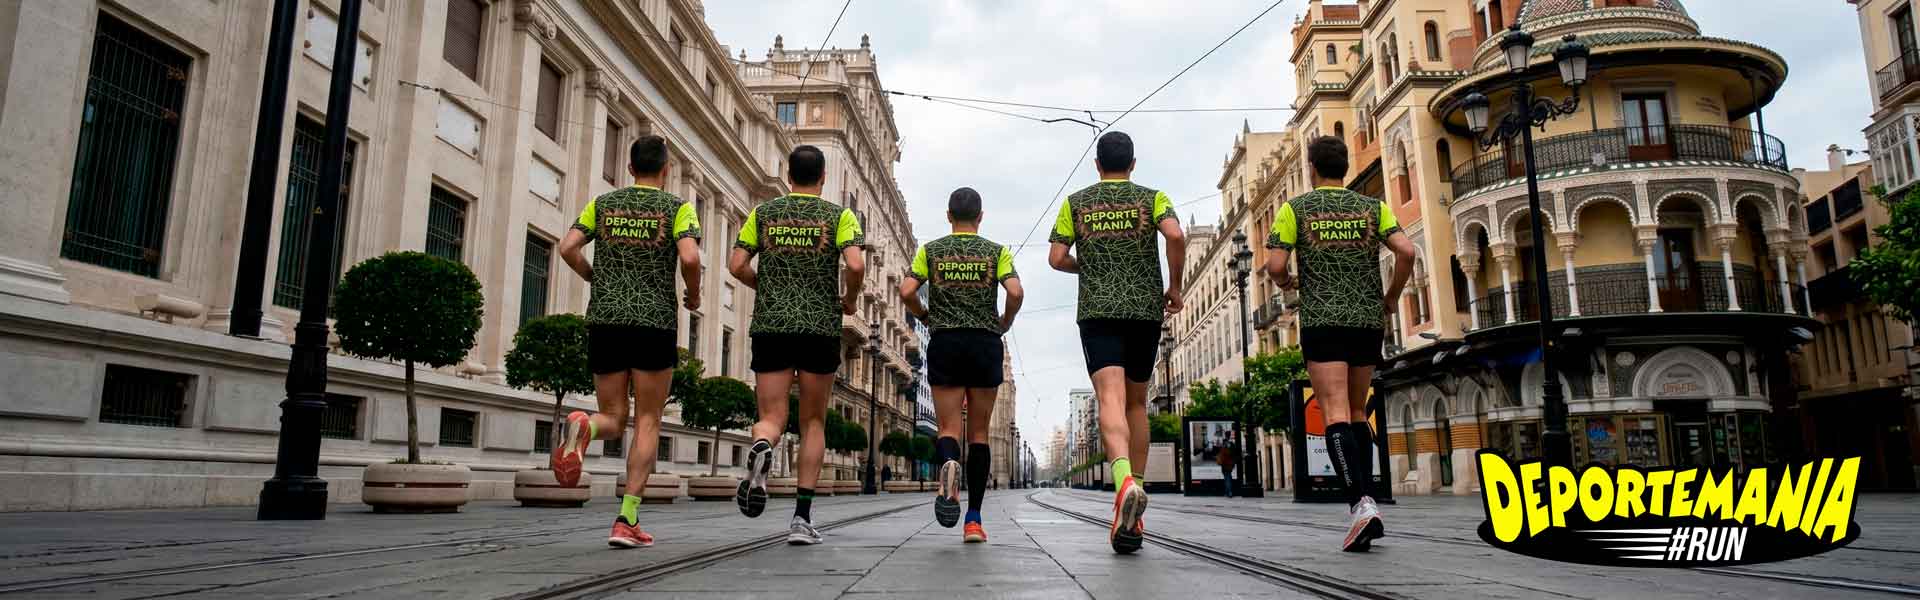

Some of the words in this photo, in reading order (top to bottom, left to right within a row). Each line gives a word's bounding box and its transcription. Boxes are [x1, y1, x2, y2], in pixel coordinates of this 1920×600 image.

[1084, 209, 1138, 223] DEPORTE
[605, 217, 658, 229] DEPORTE
[1092, 220, 1133, 232] MANIA
[1311, 219, 1367, 230] DEPORTE
[612, 227, 650, 239] MANIA
[768, 226, 821, 236] DEPORTE
[1320, 230, 1361, 240] MANIA
[775, 236, 813, 246] MANIA
[938, 262, 987, 271] DEPORTE
[944, 272, 980, 281] MANIA
